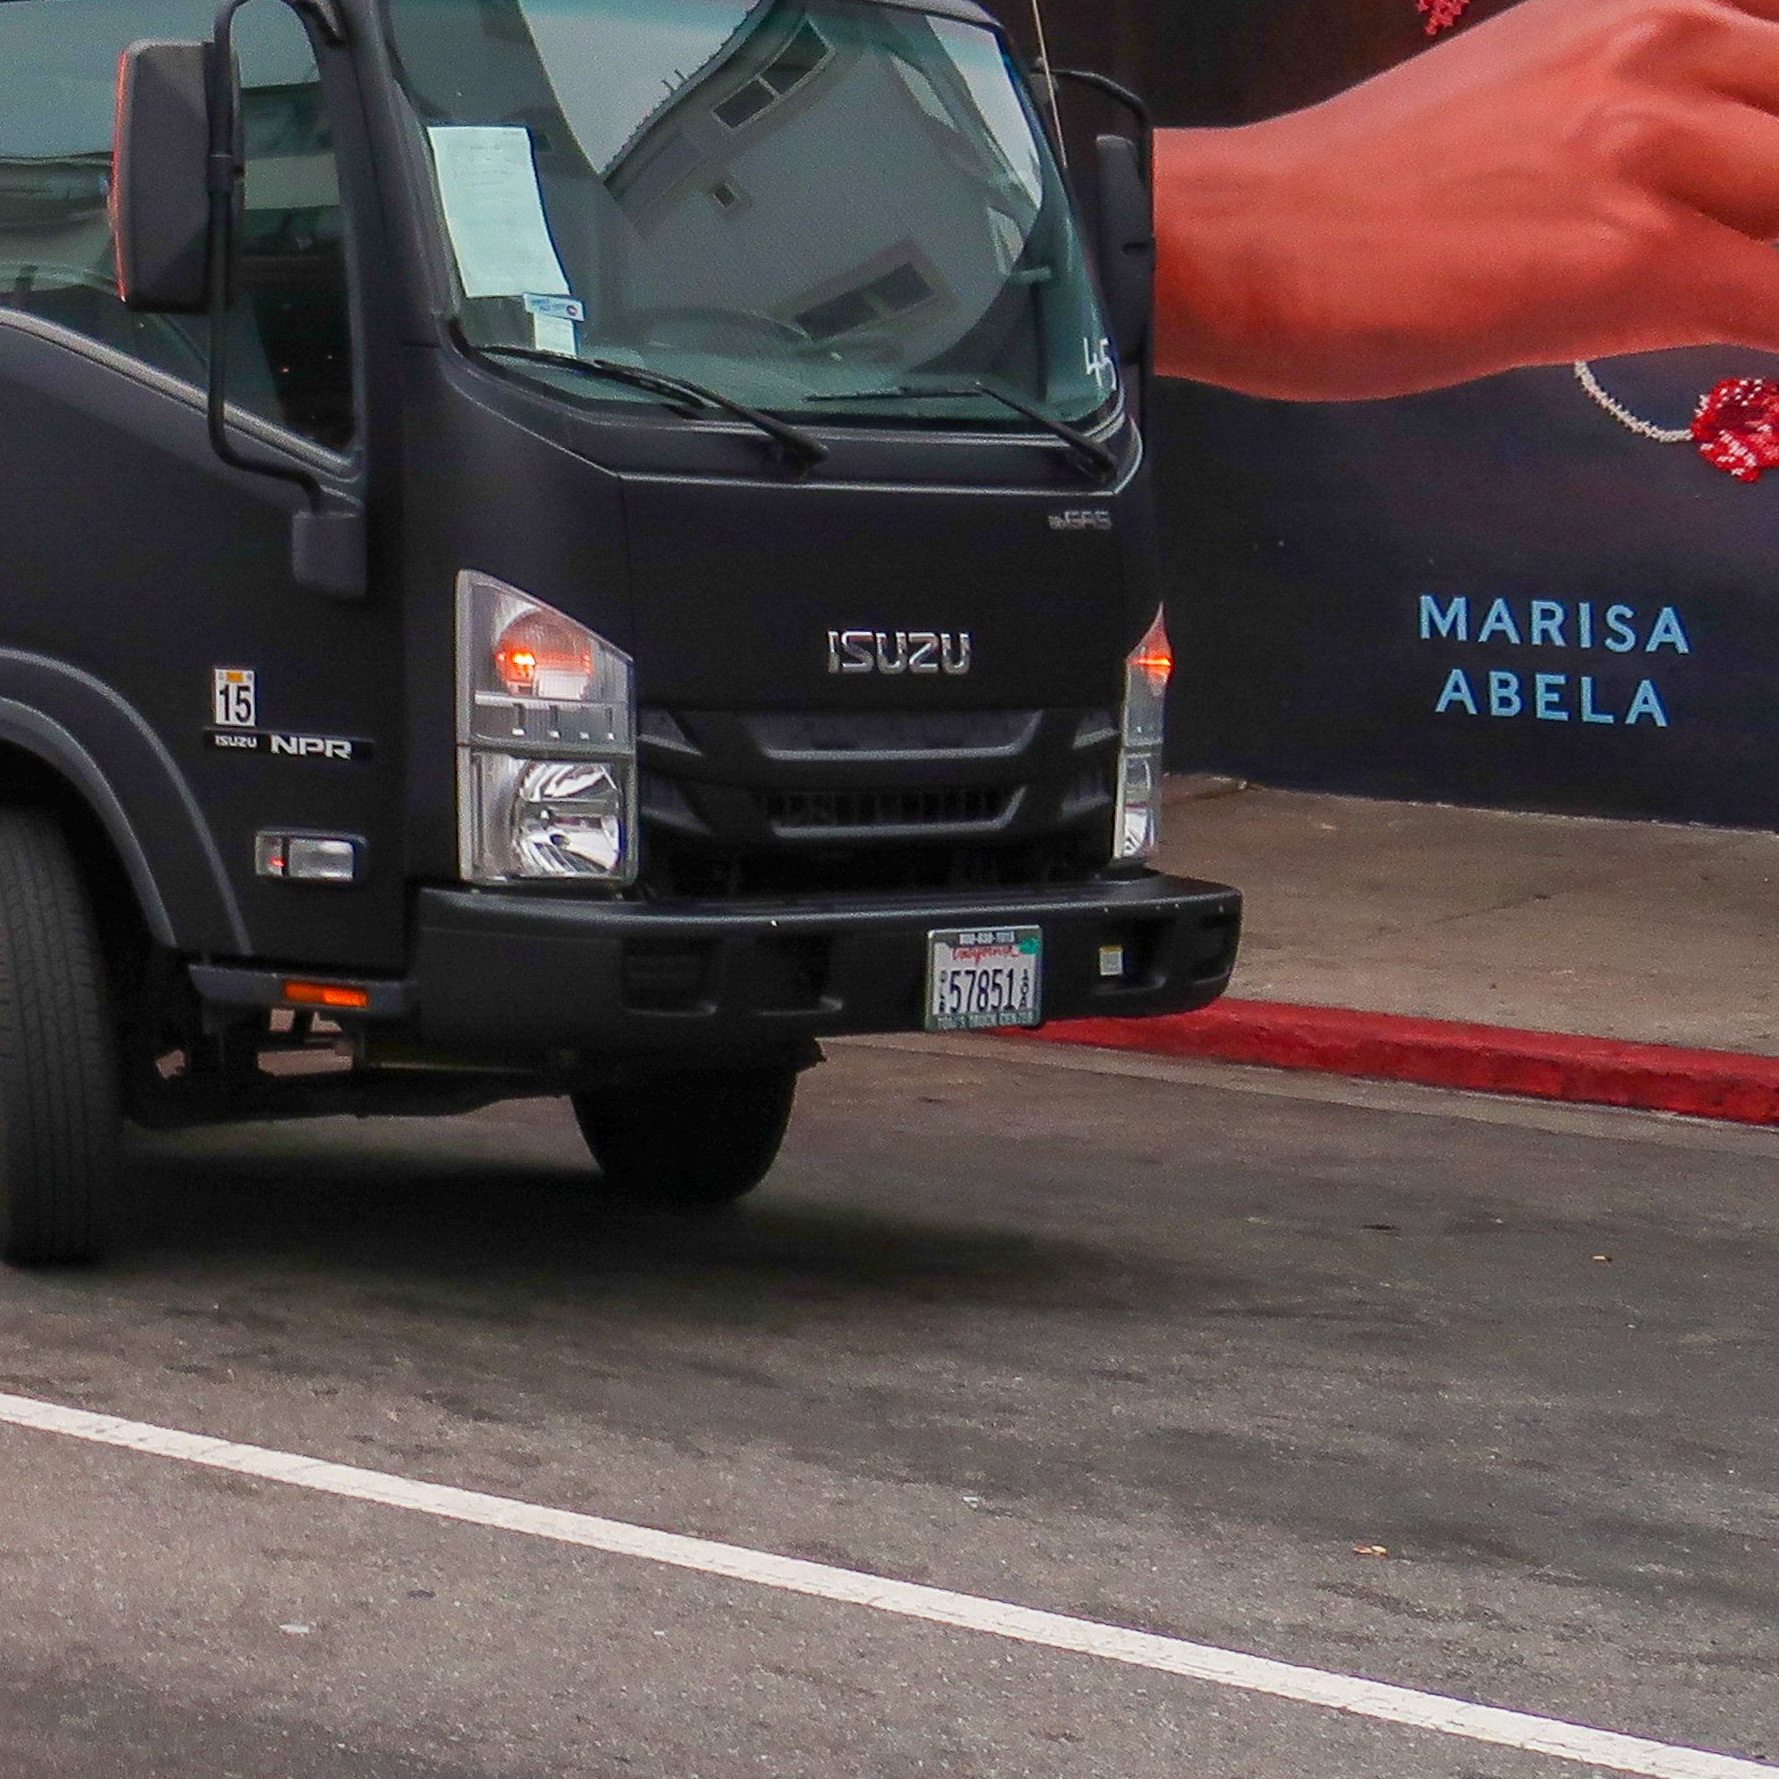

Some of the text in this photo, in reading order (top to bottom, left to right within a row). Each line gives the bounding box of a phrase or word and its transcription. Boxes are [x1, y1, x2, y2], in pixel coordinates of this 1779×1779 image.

[1418, 593, 1691, 655] MARISA
[827, 630, 971, 675] ISUZU
[219, 683, 252, 723] 15
[1434, 667, 1669, 728] ABELA
[215, 734, 353, 760] ISUZU NPR
[950, 968, 1016, 1014] 57851
